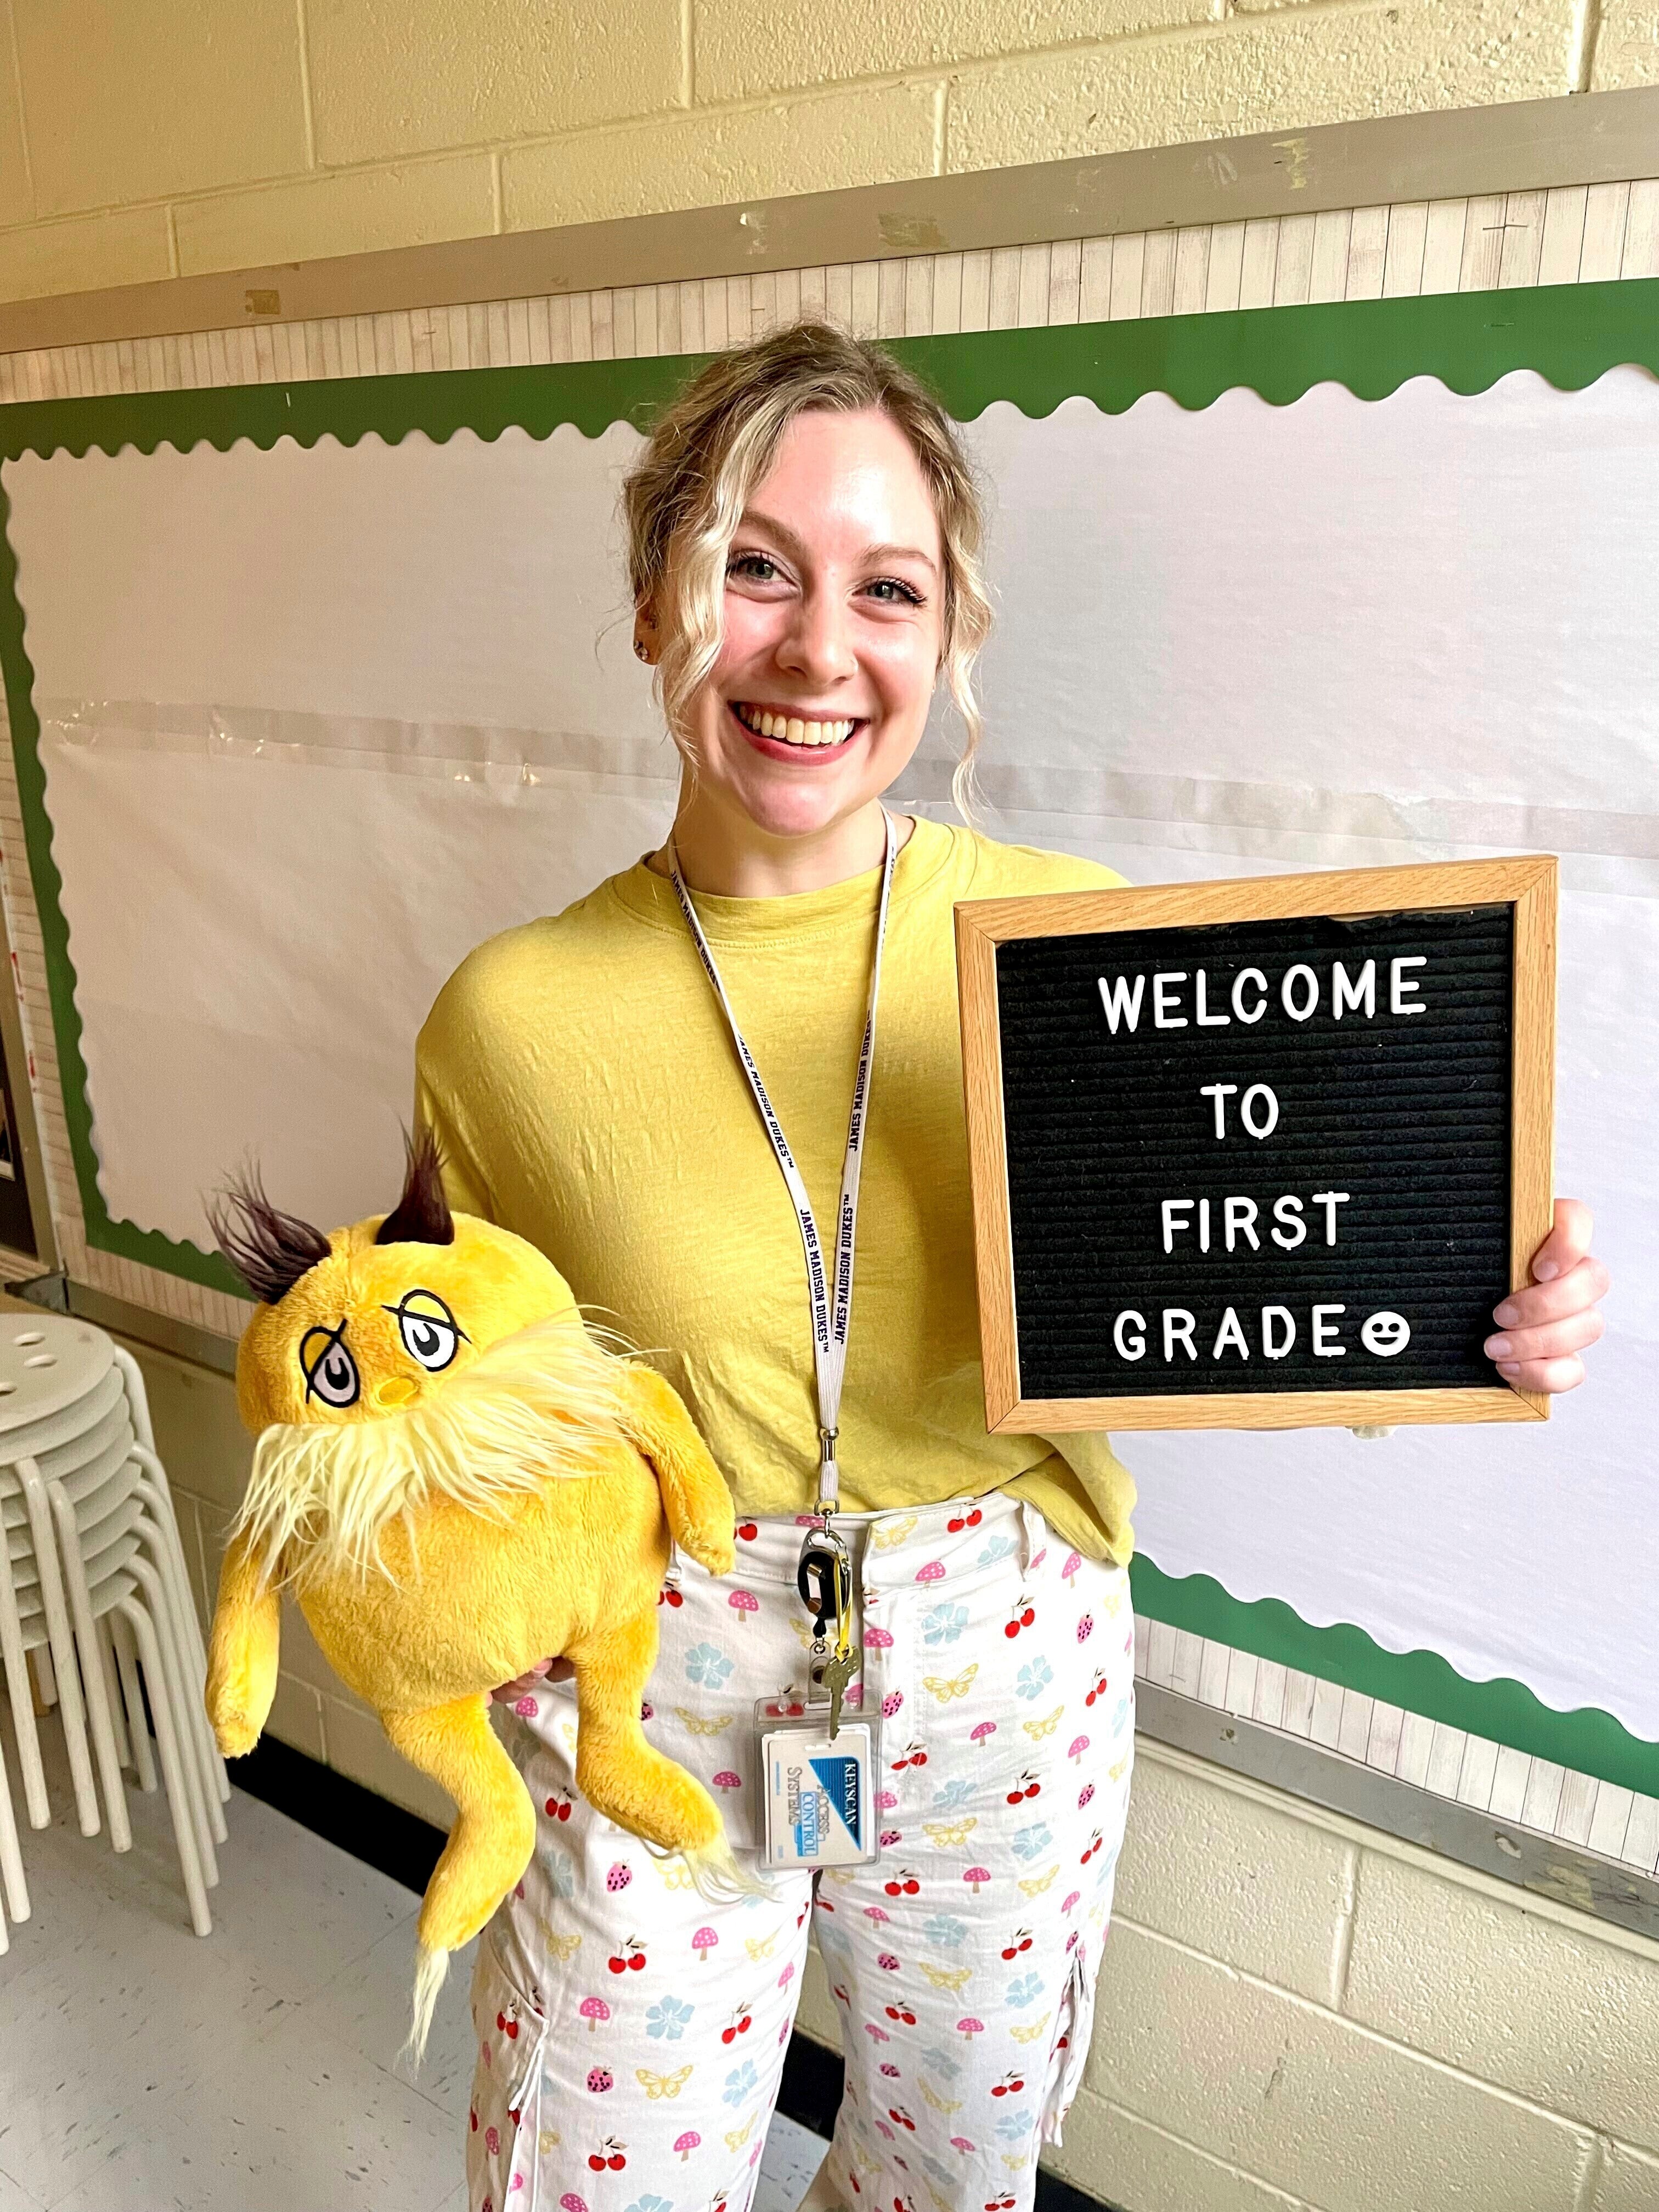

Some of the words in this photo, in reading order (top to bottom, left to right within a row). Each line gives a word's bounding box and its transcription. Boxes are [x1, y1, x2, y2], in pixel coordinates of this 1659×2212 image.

[1098, 956, 1427, 1034] WELCOME
[751, 1070, 774, 1118] MADISON
[854, 1059, 867, 1110] MADISON
[1200, 1084, 1279, 1139] TO
[849, 1113, 861, 1152] JAMES
[1161, 1191, 1350, 1253] FIRST
[800, 1209, 817, 1248] JAMES
[810, 1250, 825, 1302] MADISON
[838, 1251, 850, 1304] MADISON
[835, 1307, 847, 1344] JAMES
[1113, 1304, 1346, 1362] GRADE
[787, 1767, 803, 1826] SYSTEMS
[817, 1784, 830, 1834] ACCESS
[845, 1763, 857, 1825] KEYSCAN
[802, 1794, 815, 1855] CONTROL
